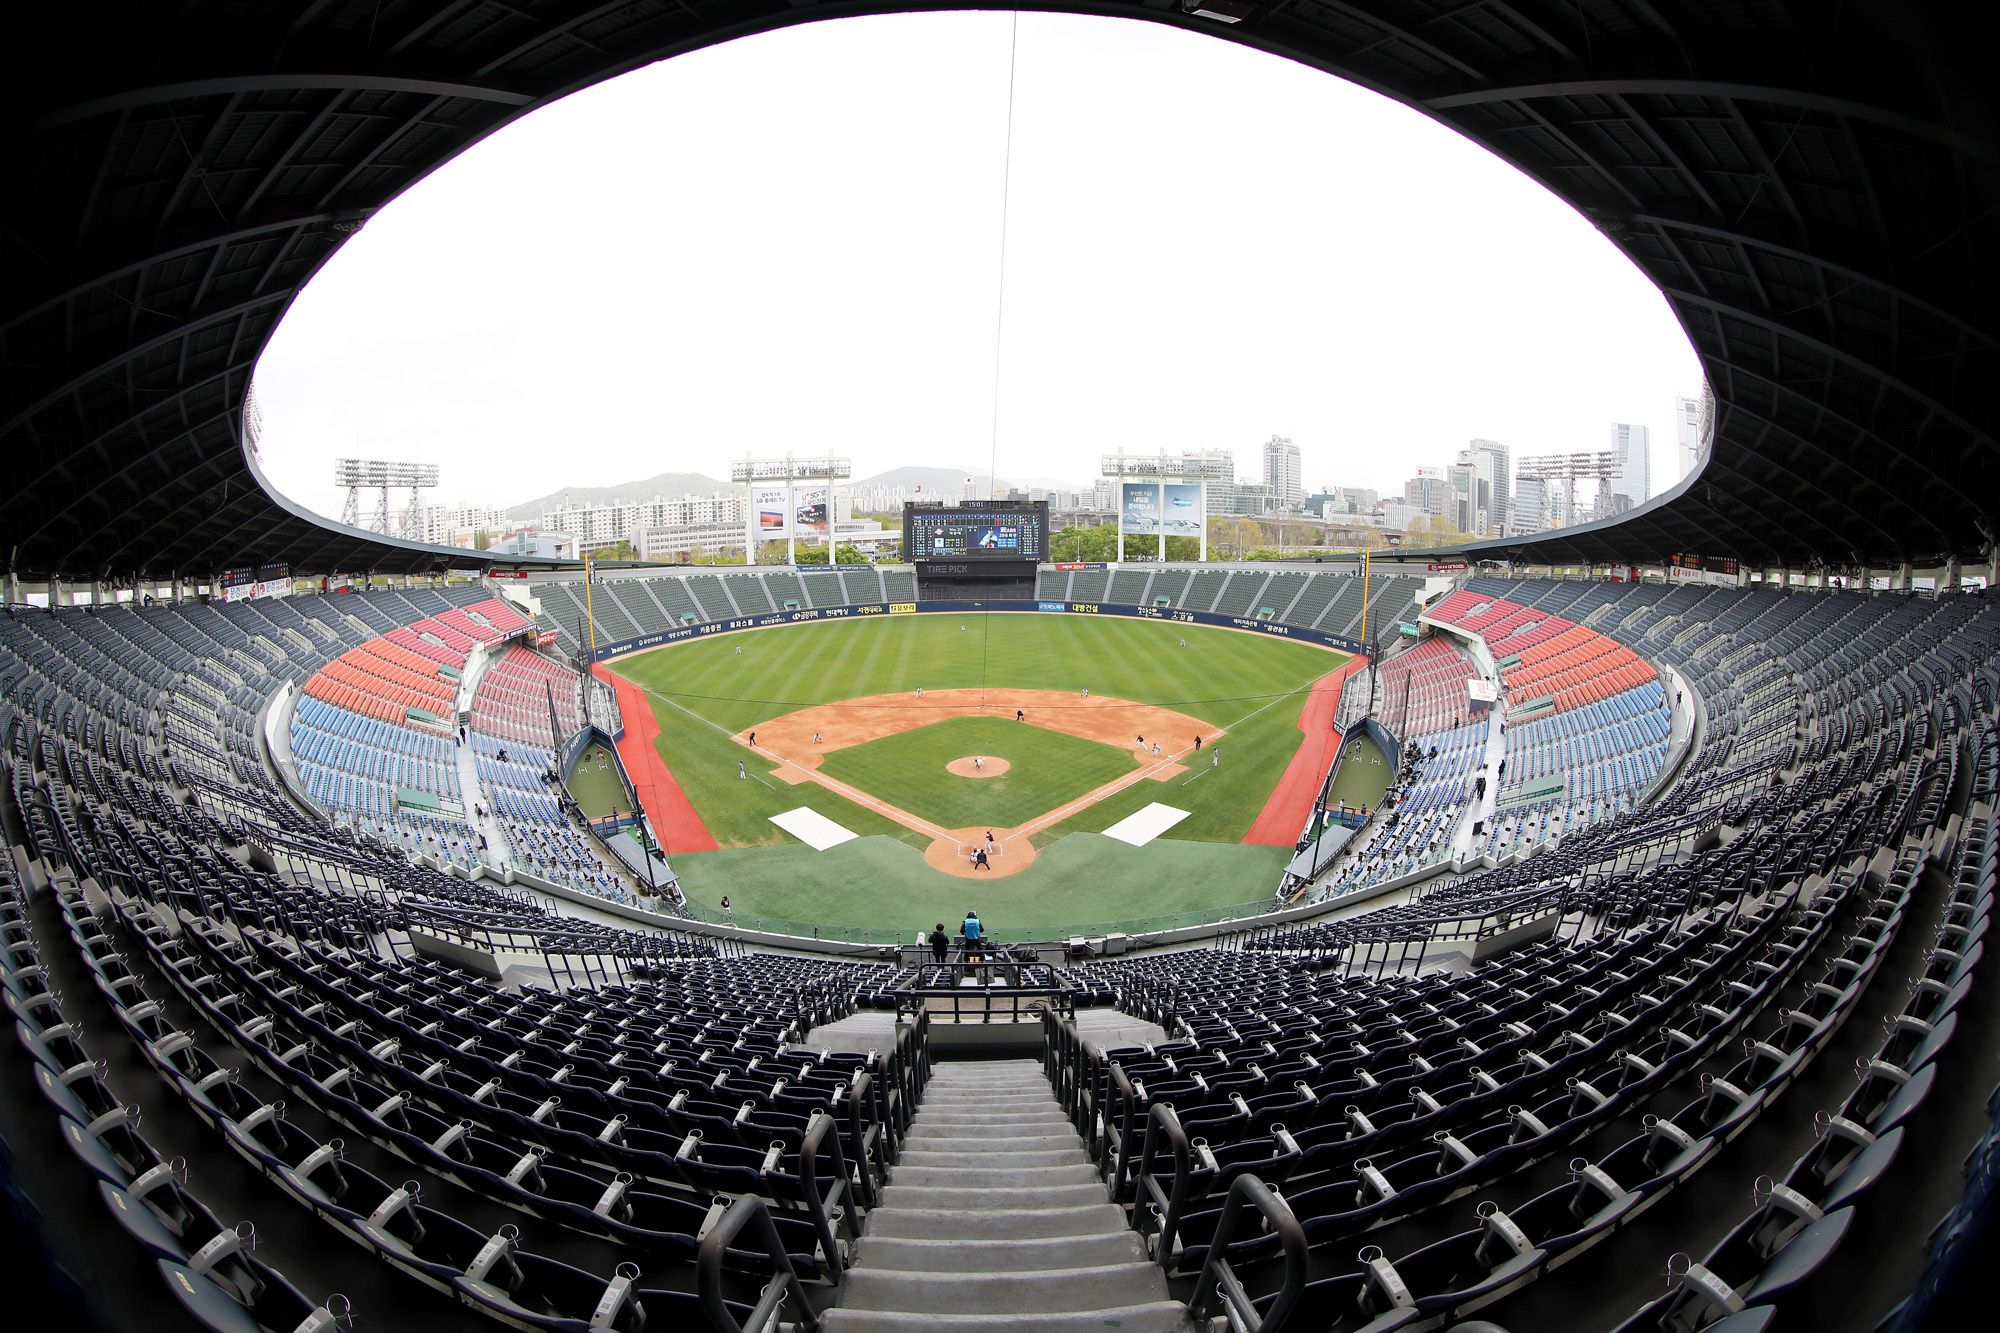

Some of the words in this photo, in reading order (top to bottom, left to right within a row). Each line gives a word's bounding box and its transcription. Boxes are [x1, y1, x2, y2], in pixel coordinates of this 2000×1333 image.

[927, 565, 947, 573] TIRE
[949, 565, 968, 573] PICK
[825, 608, 849, 617] 현대해상
[1072, 604, 1099, 613] 대방건설
[700, 623, 721, 633] 키움증권
